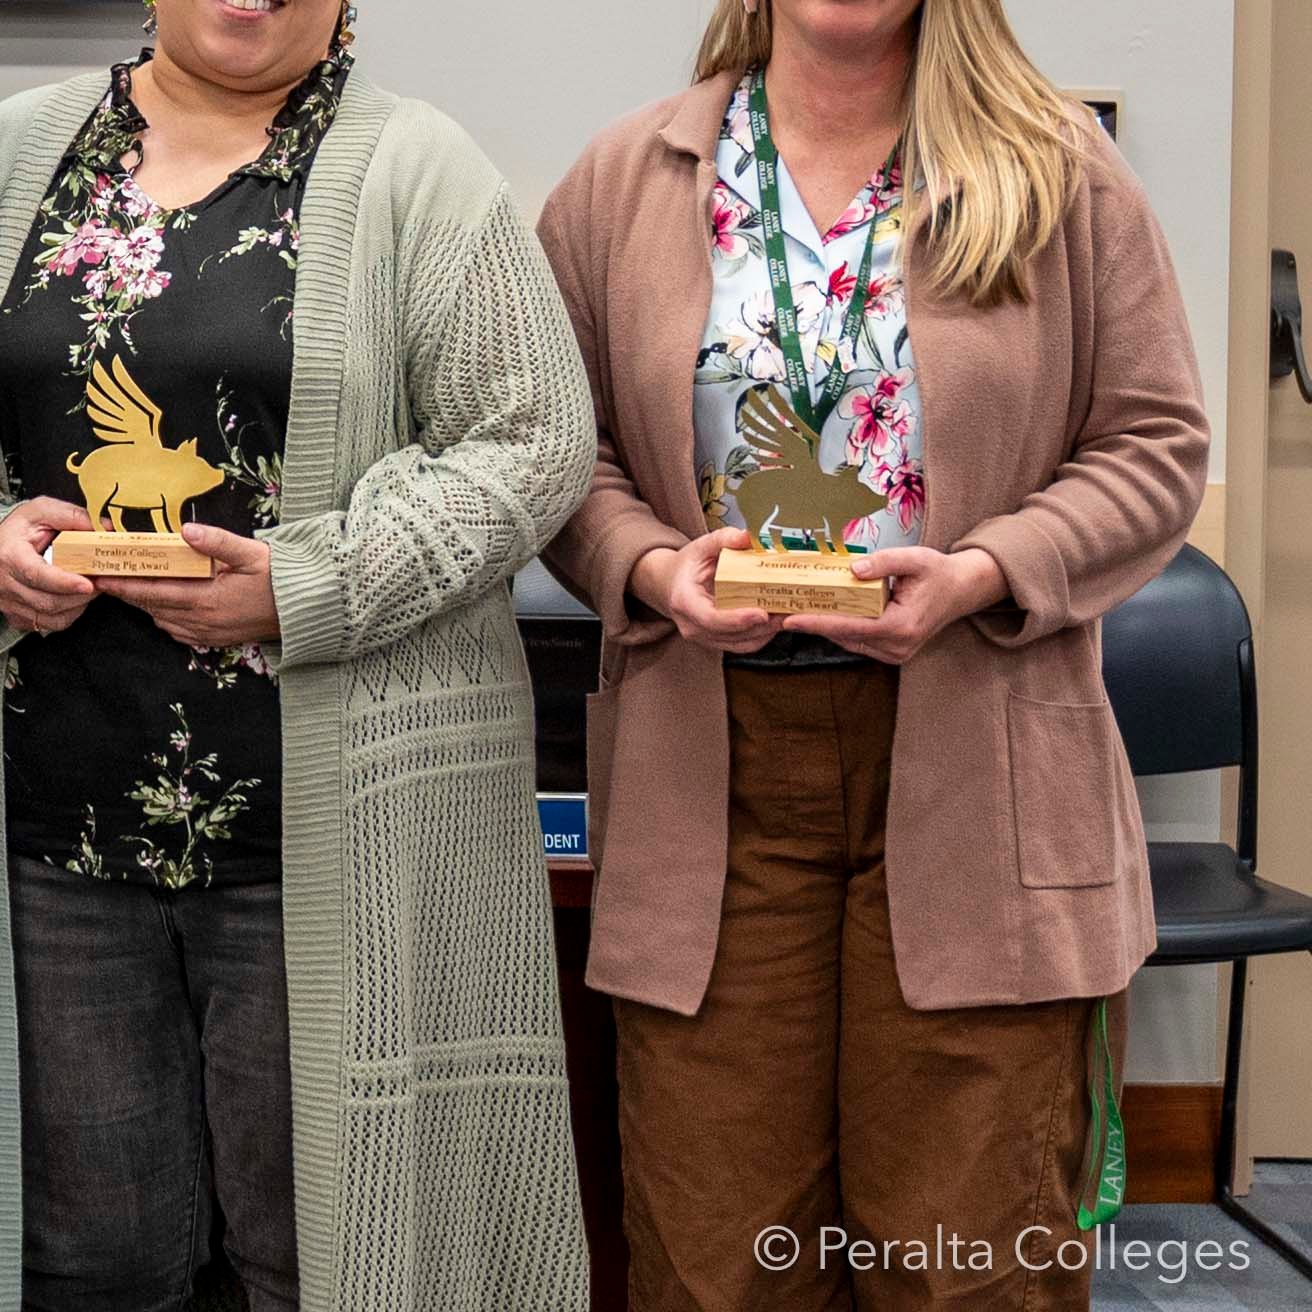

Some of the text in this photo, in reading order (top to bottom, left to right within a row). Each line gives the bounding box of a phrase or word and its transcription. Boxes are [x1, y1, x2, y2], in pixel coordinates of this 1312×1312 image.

[96, 548, 127, 556] Peralta
[123, 561, 137, 571] Pig
[140, 561, 168, 570] Award
[544, 833, 581, 849] DENT
[1099, 1121, 1122, 1205] LANEY
